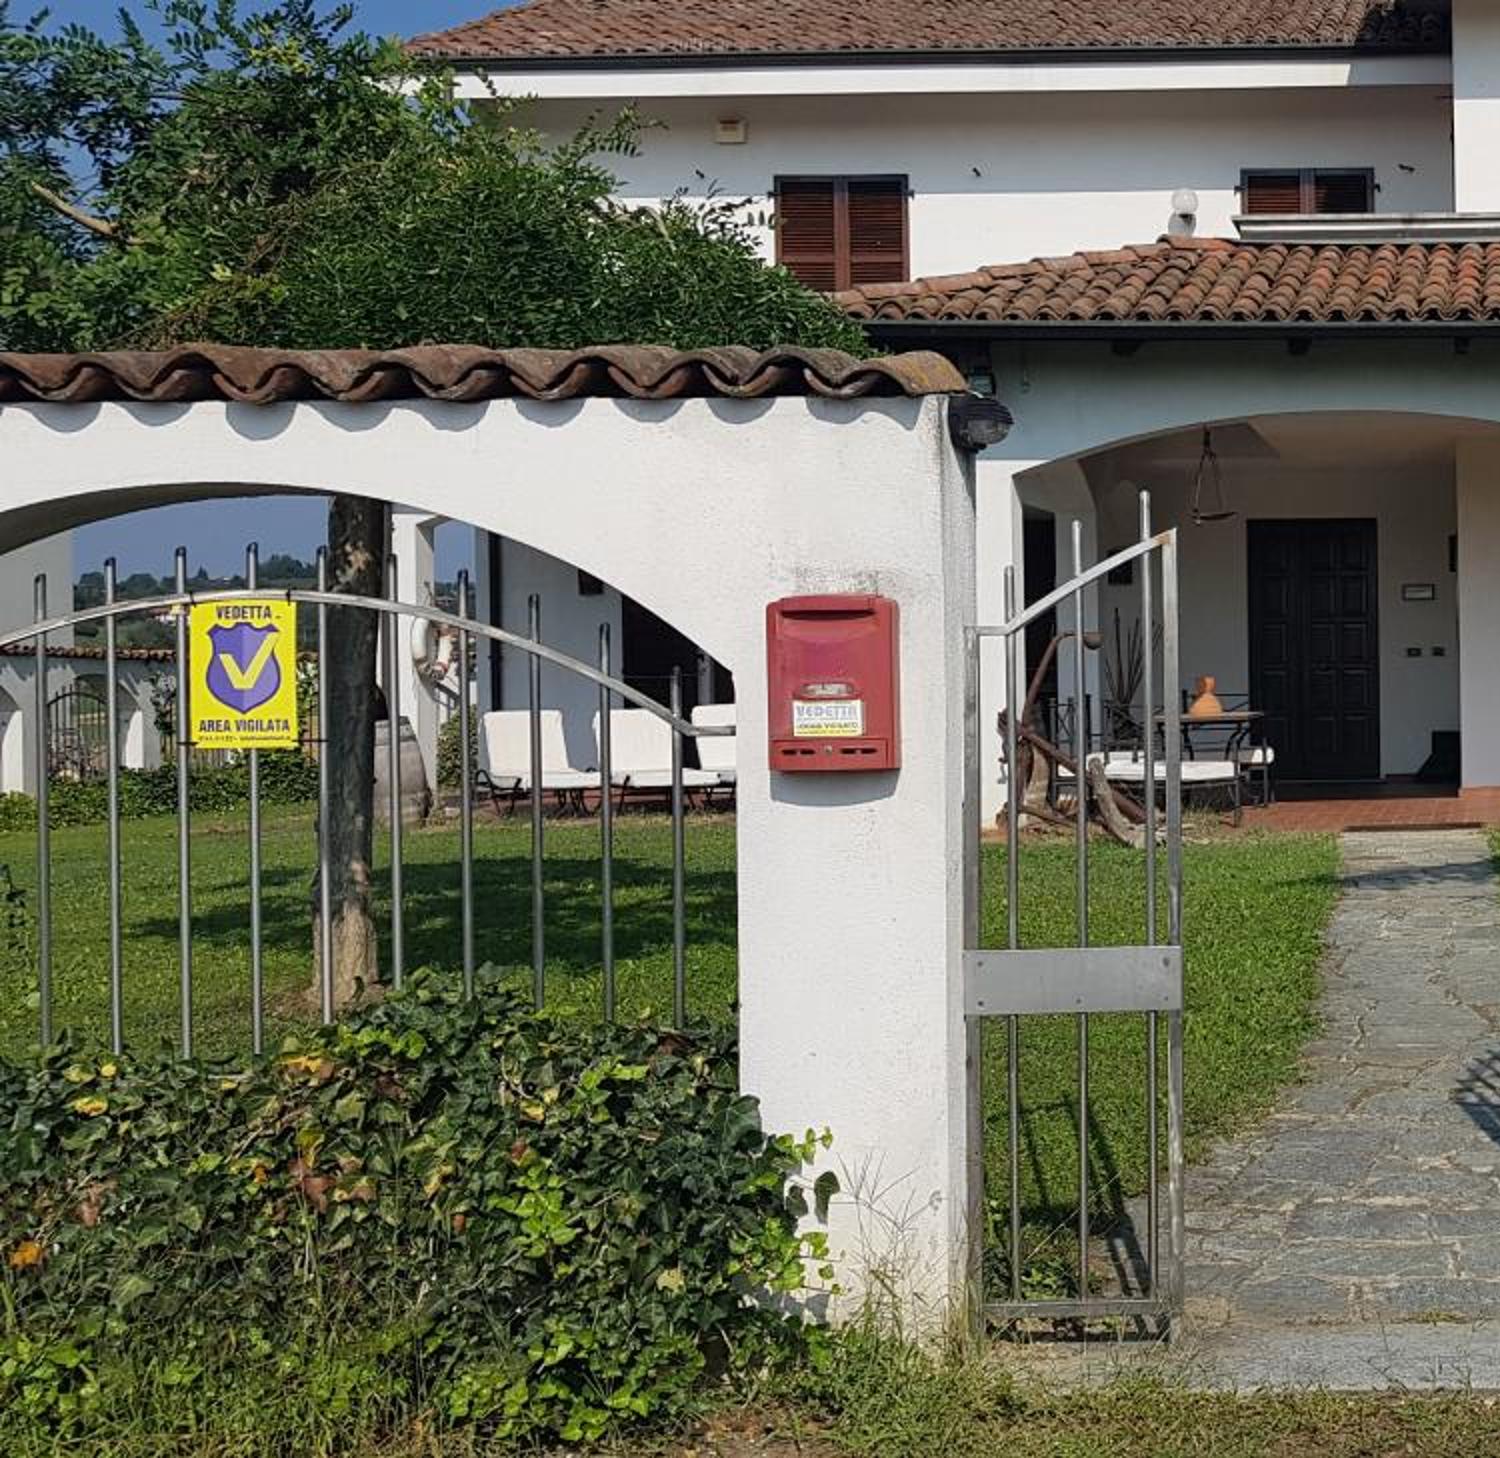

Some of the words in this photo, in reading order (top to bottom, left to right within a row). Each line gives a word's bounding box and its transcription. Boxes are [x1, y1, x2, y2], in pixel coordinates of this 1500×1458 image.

[216, 605, 272, 620] VEDETTA
[796, 705, 857, 717] VEDETTA
[199, 718, 231, 732] AREA
[235, 718, 290, 732] VIGILATA
